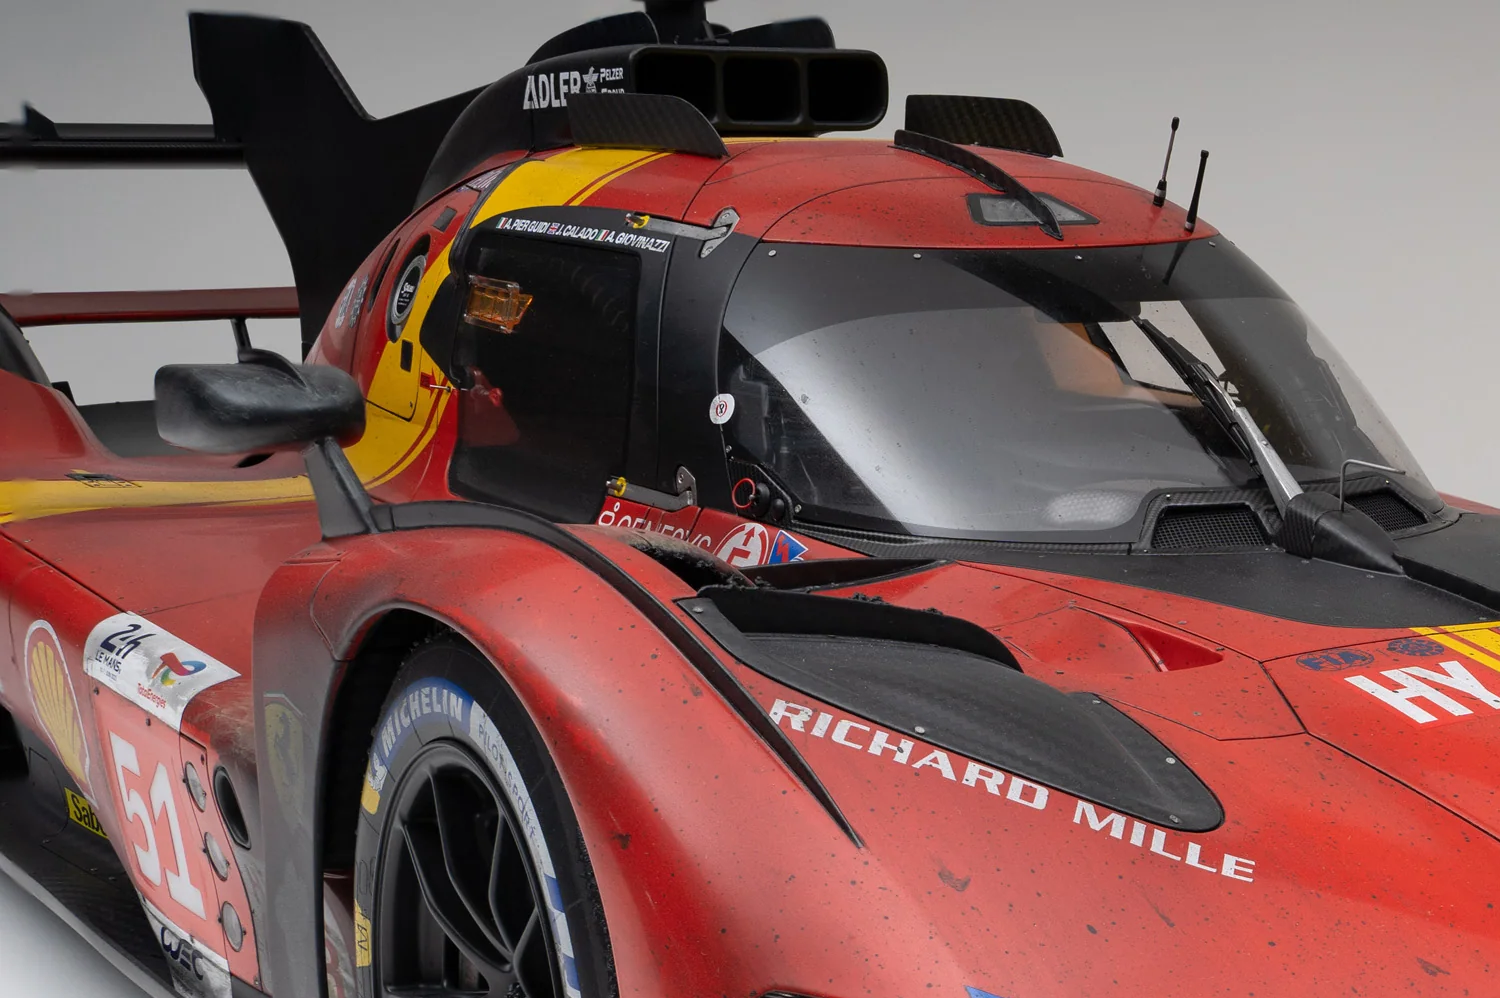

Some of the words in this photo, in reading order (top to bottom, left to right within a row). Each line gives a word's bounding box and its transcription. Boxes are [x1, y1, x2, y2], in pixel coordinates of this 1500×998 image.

[600, 67, 624, 82] PELZER
[510, 219, 528, 232] PIER
[528, 221, 551, 234] GUIDI
[562, 225, 599, 241] CALADO
[615, 233, 671, 253] GIOVINAZZI
[1301, 650, 1368, 671] FIA
[381, 686, 464, 758] MICHELIN
[769, 698, 1050, 811] RICHARD
[1072, 799, 1255, 883] MILLE
[108, 731, 207, 921] 51
